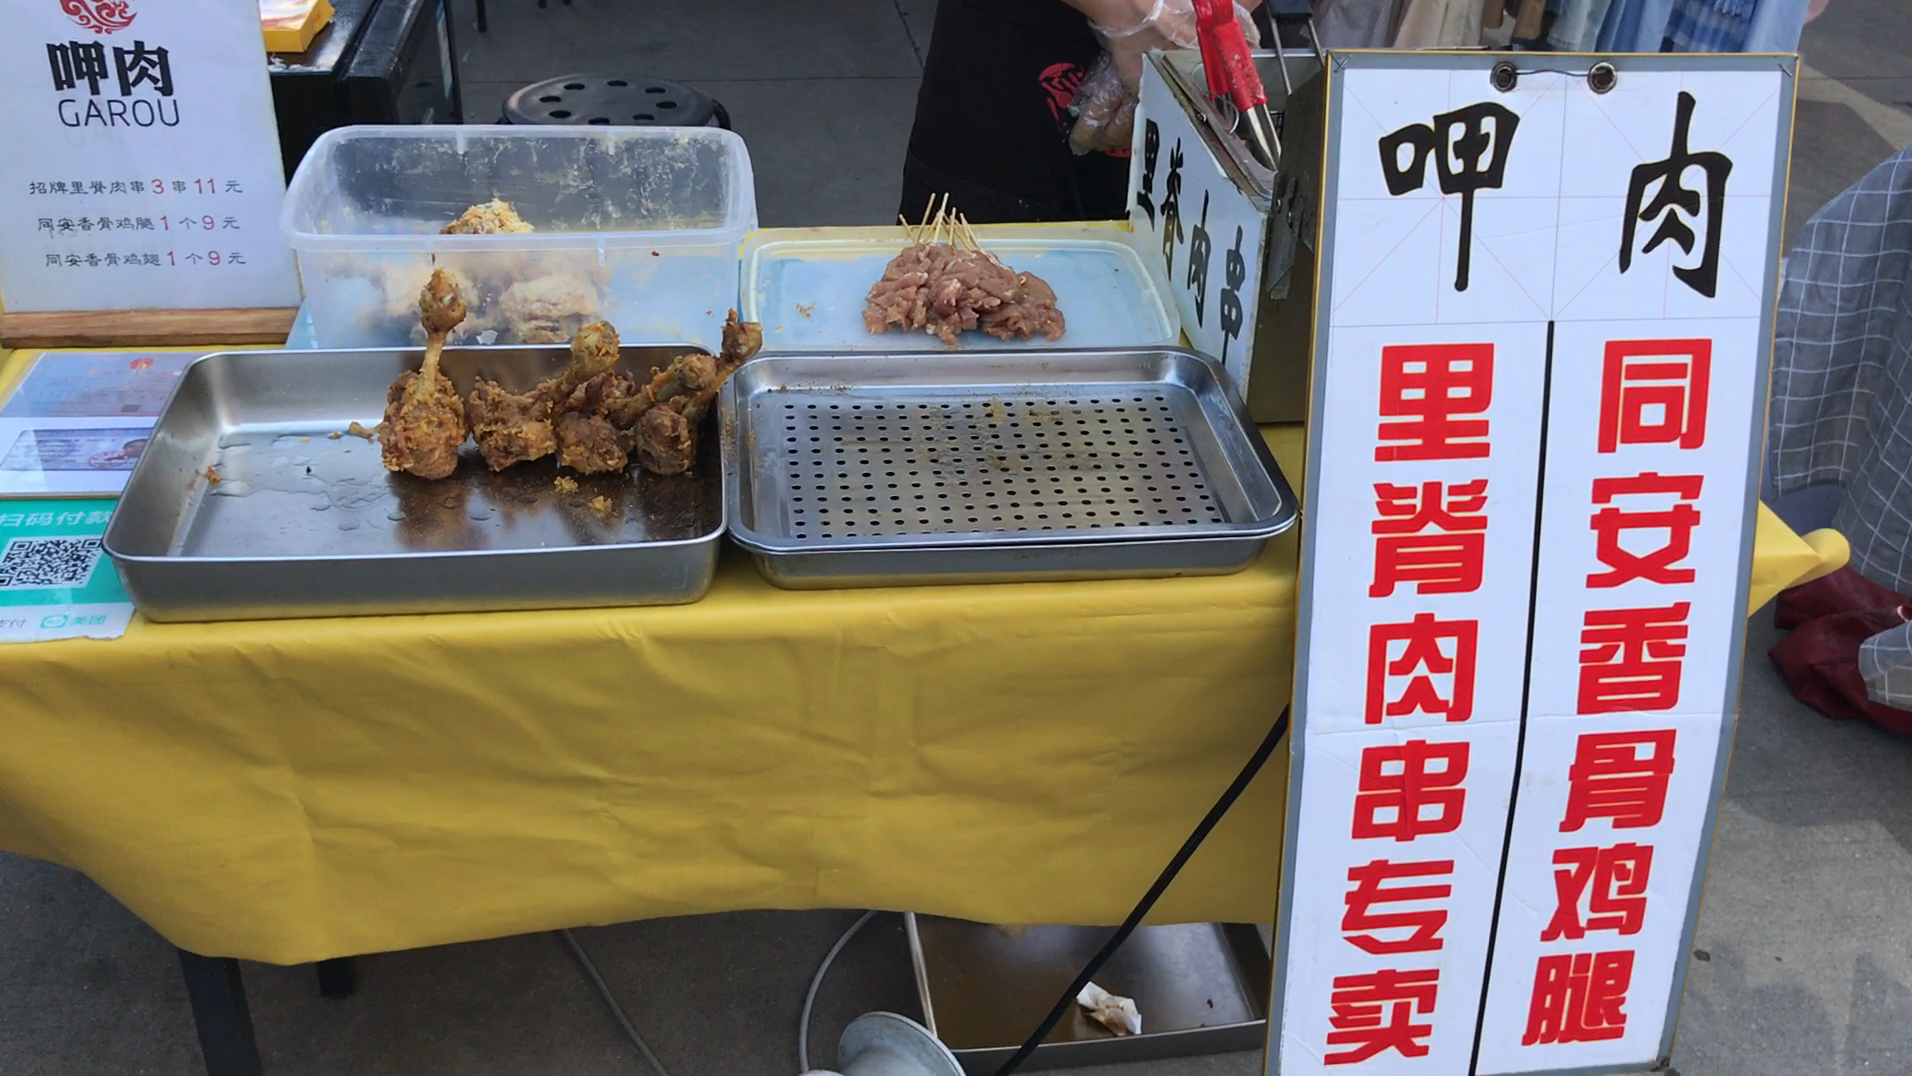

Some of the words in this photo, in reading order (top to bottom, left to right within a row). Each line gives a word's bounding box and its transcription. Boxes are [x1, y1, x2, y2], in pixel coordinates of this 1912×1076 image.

[46, 40, 174, 96] 呷肉
[58, 99, 180, 127] GAROU
[38, 215, 241, 231] 同安香骨鸡腿1个9元
[1378, 90, 1733, 298] 呷肉
[1324, 342, 1494, 1066] 里脊肉串专卖
[1521, 338, 1712, 1047] 同安香骨鸡腿
